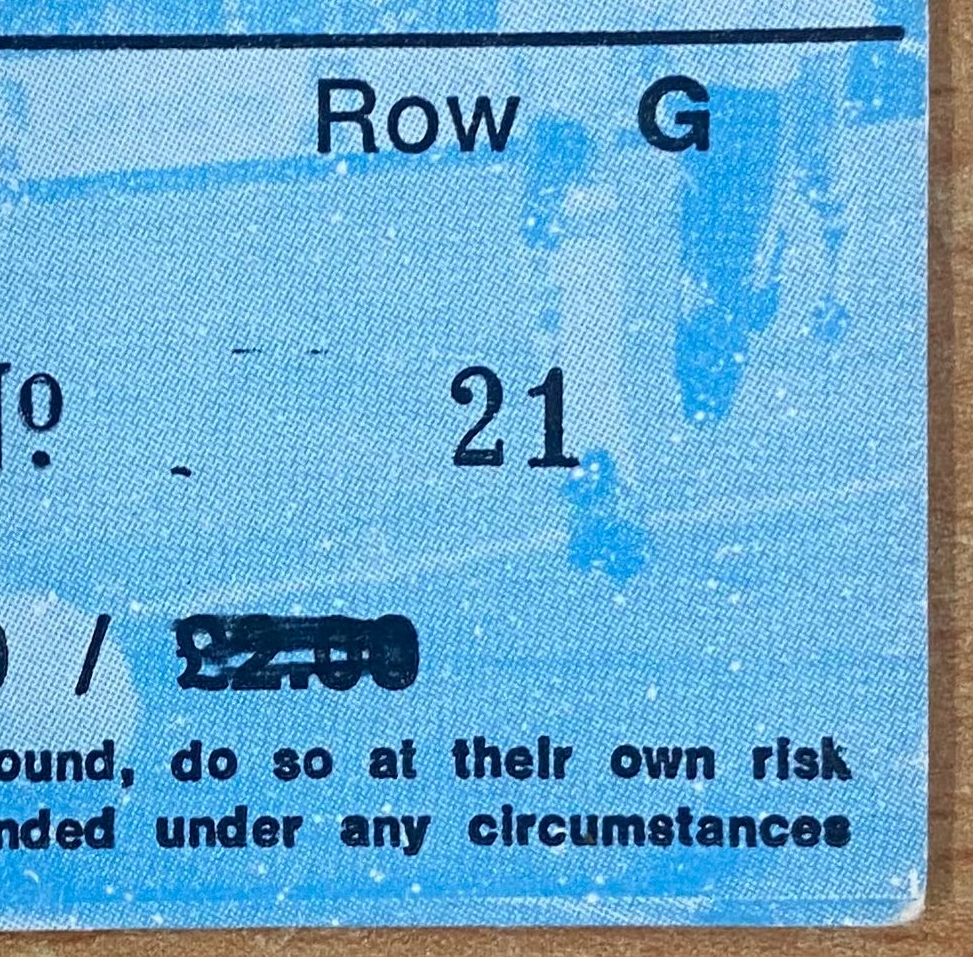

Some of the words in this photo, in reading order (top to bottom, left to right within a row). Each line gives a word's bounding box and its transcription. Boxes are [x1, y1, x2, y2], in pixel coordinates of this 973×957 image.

[318, 79, 520, 153] Row
[638, 76, 709, 152] G
[451, 367, 579, 468] 21
[171, 740, 237, 782] do
[273, 748, 332, 781] so
[369, 740, 416, 779] at
[452, 736, 572, 780] their
[611, 745, 715, 780] own
[753, 737, 852, 781] risk
[156, 806, 303, 848] under
[341, 815, 430, 856] any
[469, 805, 850, 848] circumstances
